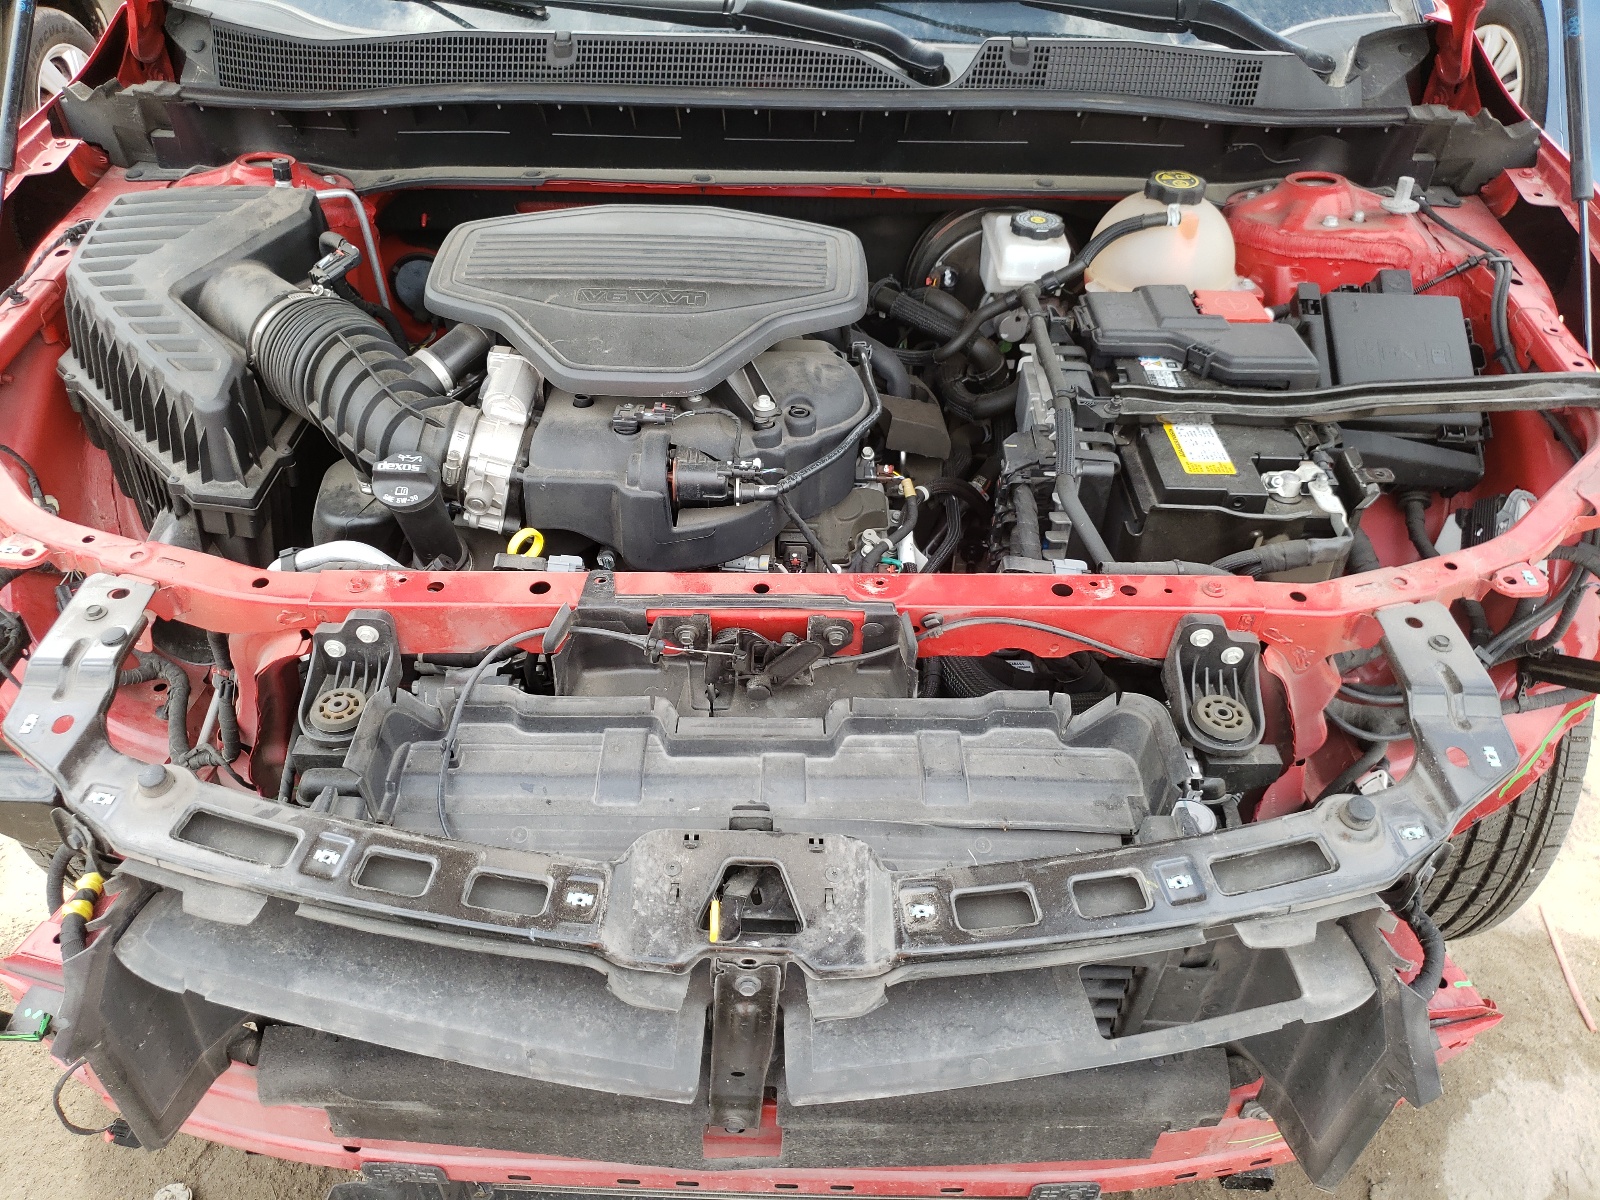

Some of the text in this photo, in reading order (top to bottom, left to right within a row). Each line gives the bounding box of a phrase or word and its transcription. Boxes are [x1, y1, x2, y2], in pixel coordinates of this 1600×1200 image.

[581, 290, 703, 305] V6 VVT
[396, 495, 418, 503] 5W-30
